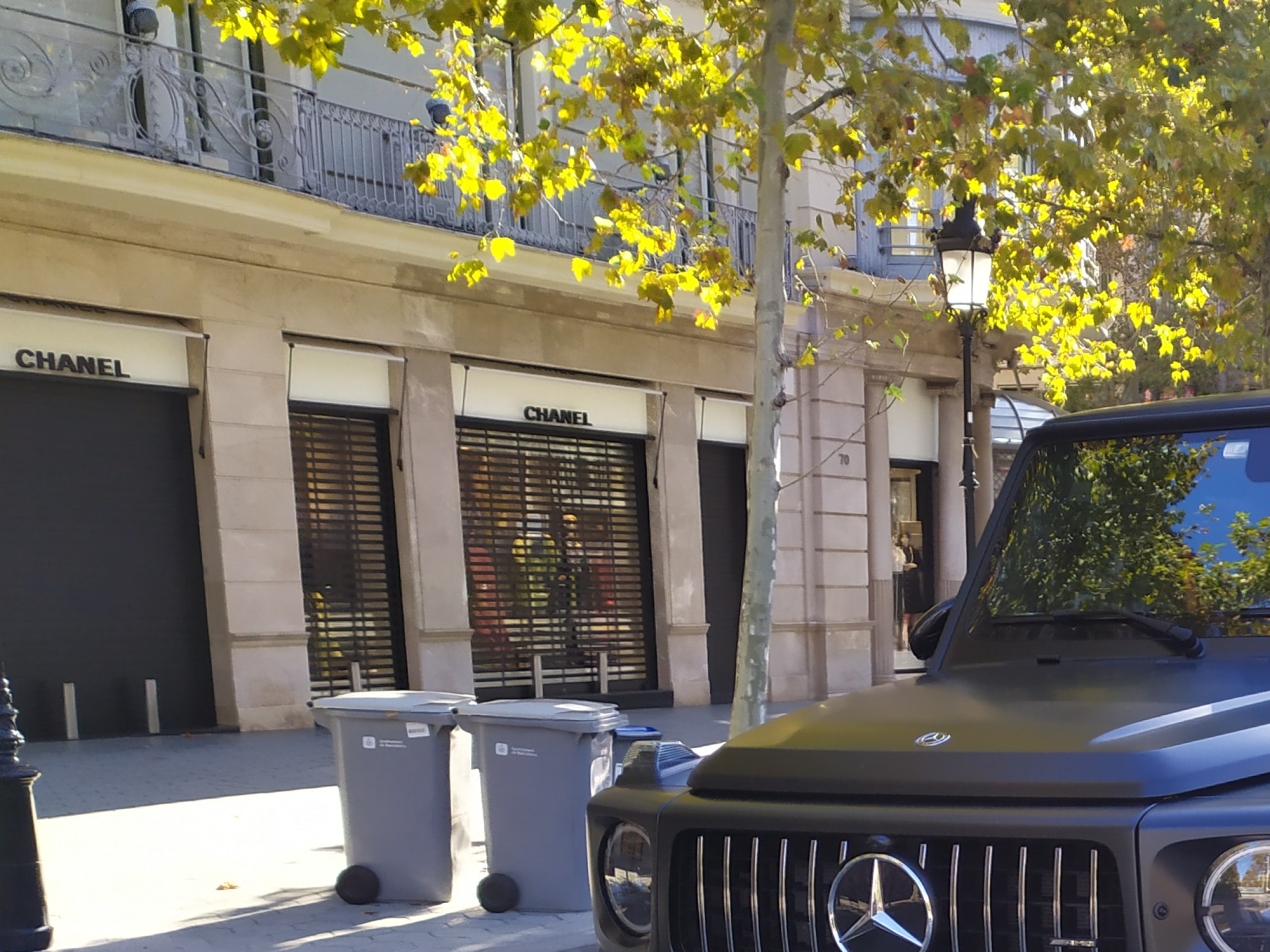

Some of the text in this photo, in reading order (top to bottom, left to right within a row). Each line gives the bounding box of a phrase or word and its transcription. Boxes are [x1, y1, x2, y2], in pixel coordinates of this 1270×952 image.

[15, 349, 130, 378] CHANEL
[523, 406, 593, 426] CHANEL
[838, 453, 850, 466] 70
